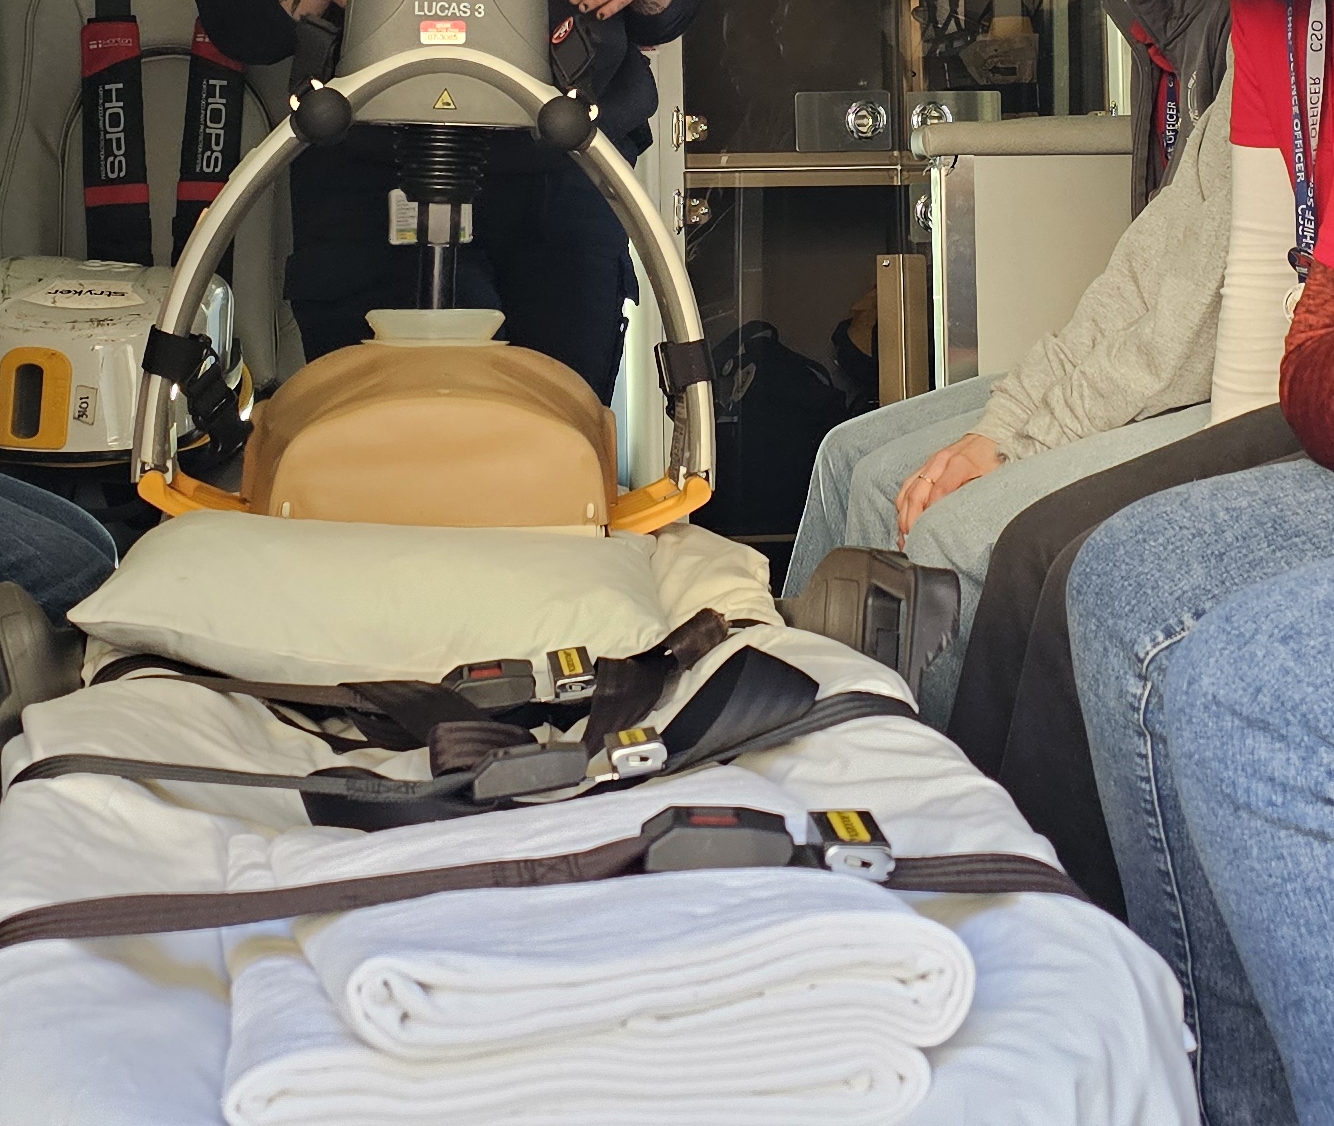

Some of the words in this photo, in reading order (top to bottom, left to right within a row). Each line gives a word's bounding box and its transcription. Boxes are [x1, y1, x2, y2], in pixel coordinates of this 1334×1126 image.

[414, 1, 471, 17] LUCAS
[474, 3, 485, 18] 3
[104, 82, 126, 179] HOPS
[202, 79, 228, 173] HOPS
[1166, 101, 1177, 144] OFFICER
[1293, 118, 1305, 183] OFFICER
[47, 288, 129, 298] stryker
